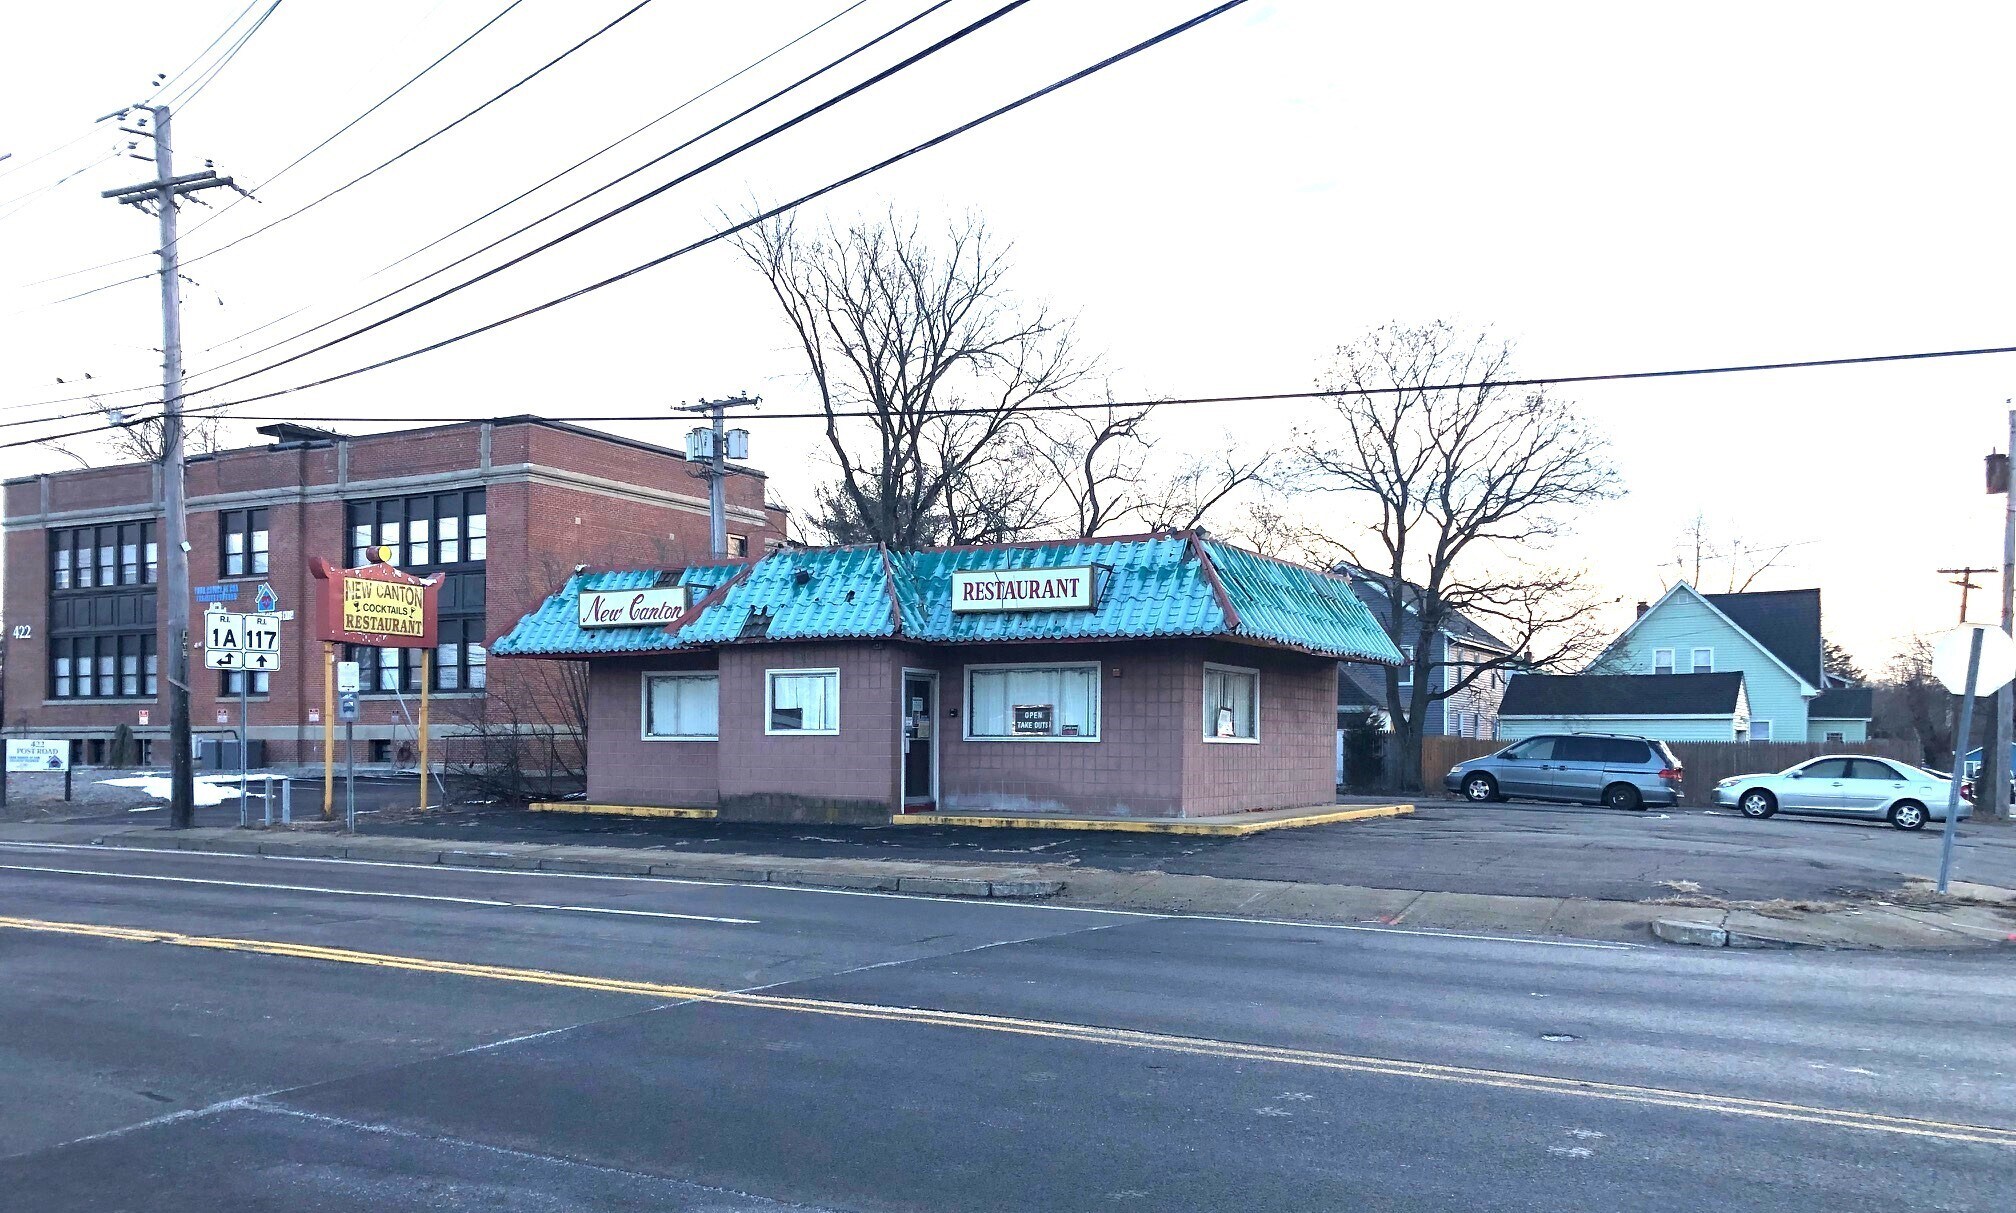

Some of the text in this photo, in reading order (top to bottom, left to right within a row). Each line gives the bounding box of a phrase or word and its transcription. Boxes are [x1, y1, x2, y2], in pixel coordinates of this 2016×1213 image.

[345, 580, 422, 608] NEW CANTON
[962, 578, 1080, 601] RESTAURANT
[363, 603, 408, 616] COCKTAILS
[583, 594, 682, 622] New Canton
[13, 625, 31, 639] 422
[346, 614, 422, 634] RESTAURANT
[213, 628, 237, 647] 1A
[246, 631, 277, 649] 117
[1024, 711, 1043, 719] OPEN
[1017, 721, 1033, 729] TAKE
